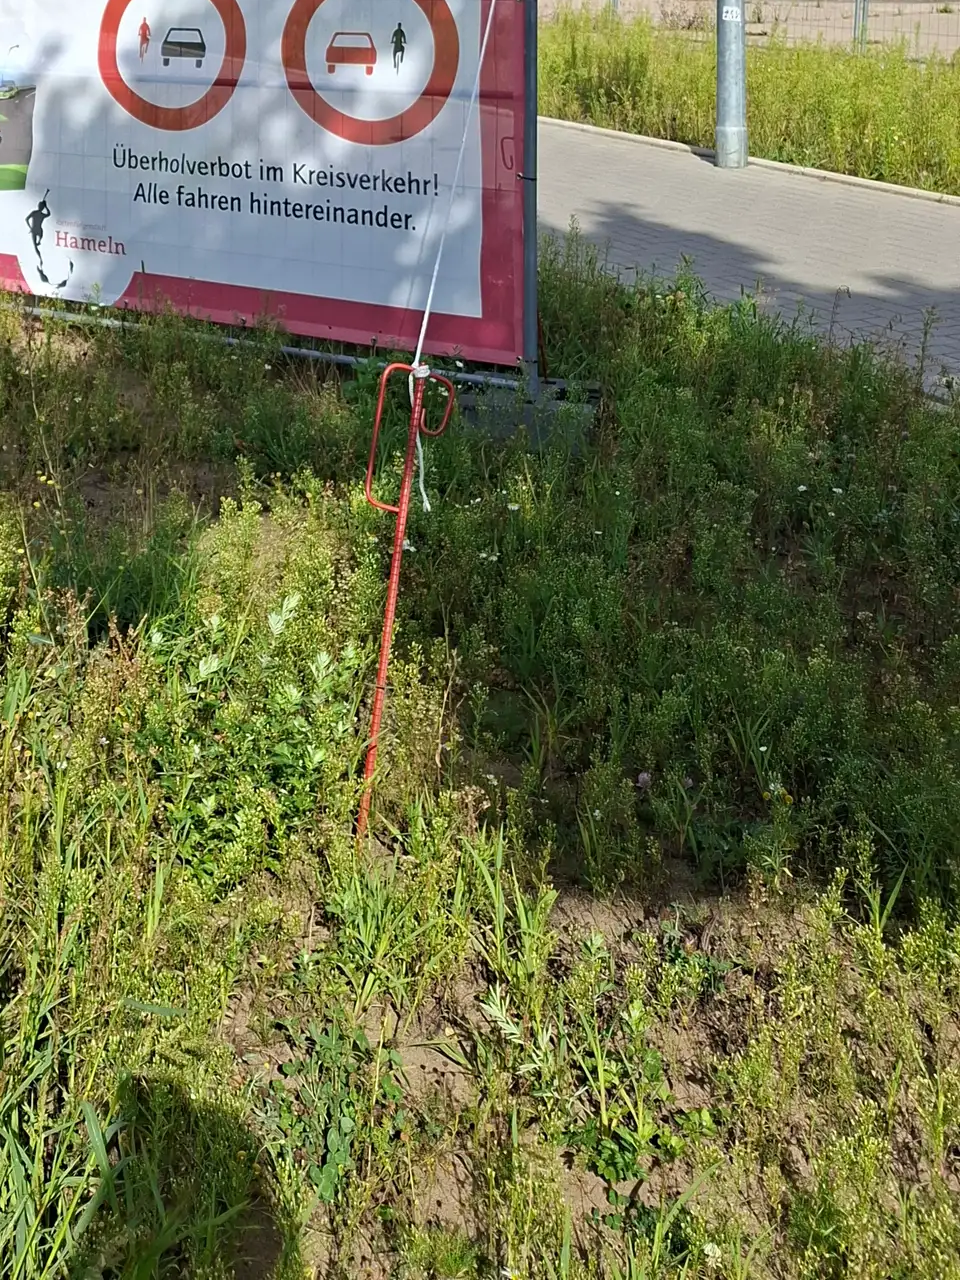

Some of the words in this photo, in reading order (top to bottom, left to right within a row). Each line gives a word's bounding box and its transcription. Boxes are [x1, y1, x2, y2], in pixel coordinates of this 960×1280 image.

[112, 143, 253, 180] Überholverbot
[258, 158, 284, 183] im
[292, 163, 439, 197] Kreisverkehr!
[133, 182, 170, 206] Alle
[176, 185, 242, 213] fahren
[249, 192, 417, 232] hintereinander.
[54, 230, 127, 256] Hameln
